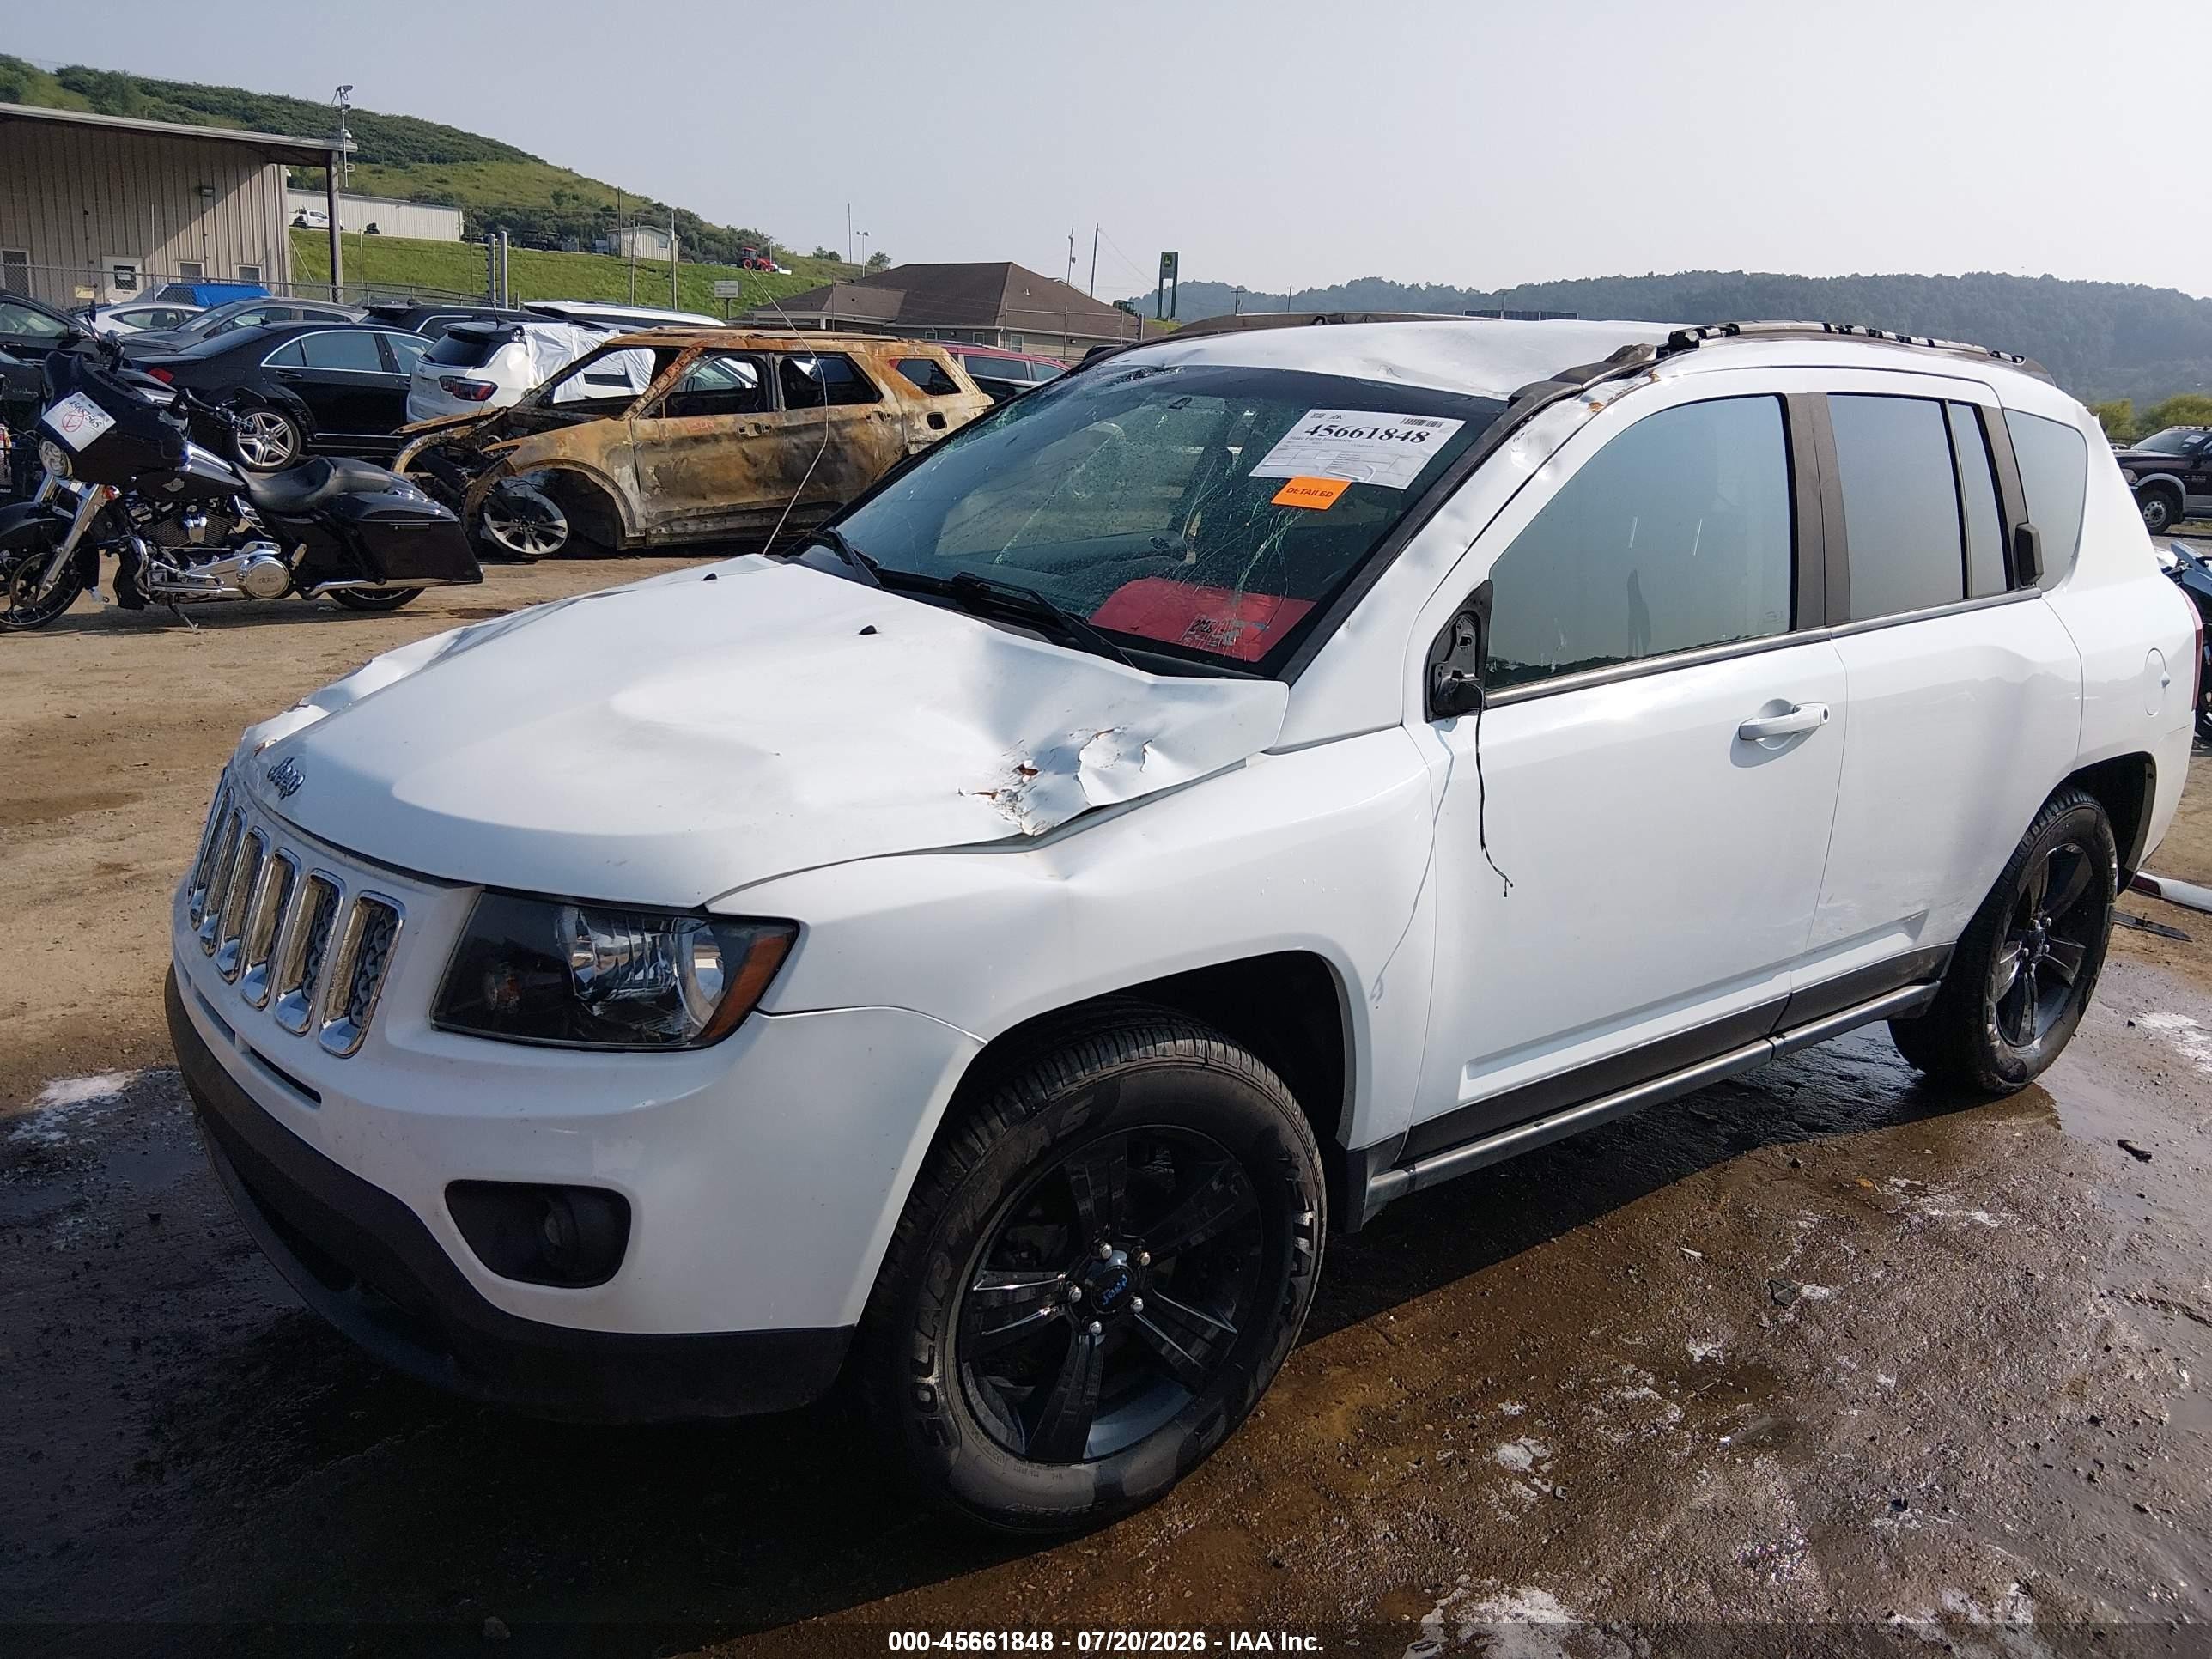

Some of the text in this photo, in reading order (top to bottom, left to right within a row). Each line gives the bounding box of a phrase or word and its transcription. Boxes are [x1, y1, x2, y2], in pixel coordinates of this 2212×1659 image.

[1304, 424, 1431, 444] 45661848
[1287, 487, 1333, 498] DETAILED
[1102, 1273, 1127, 1305] Jeep
